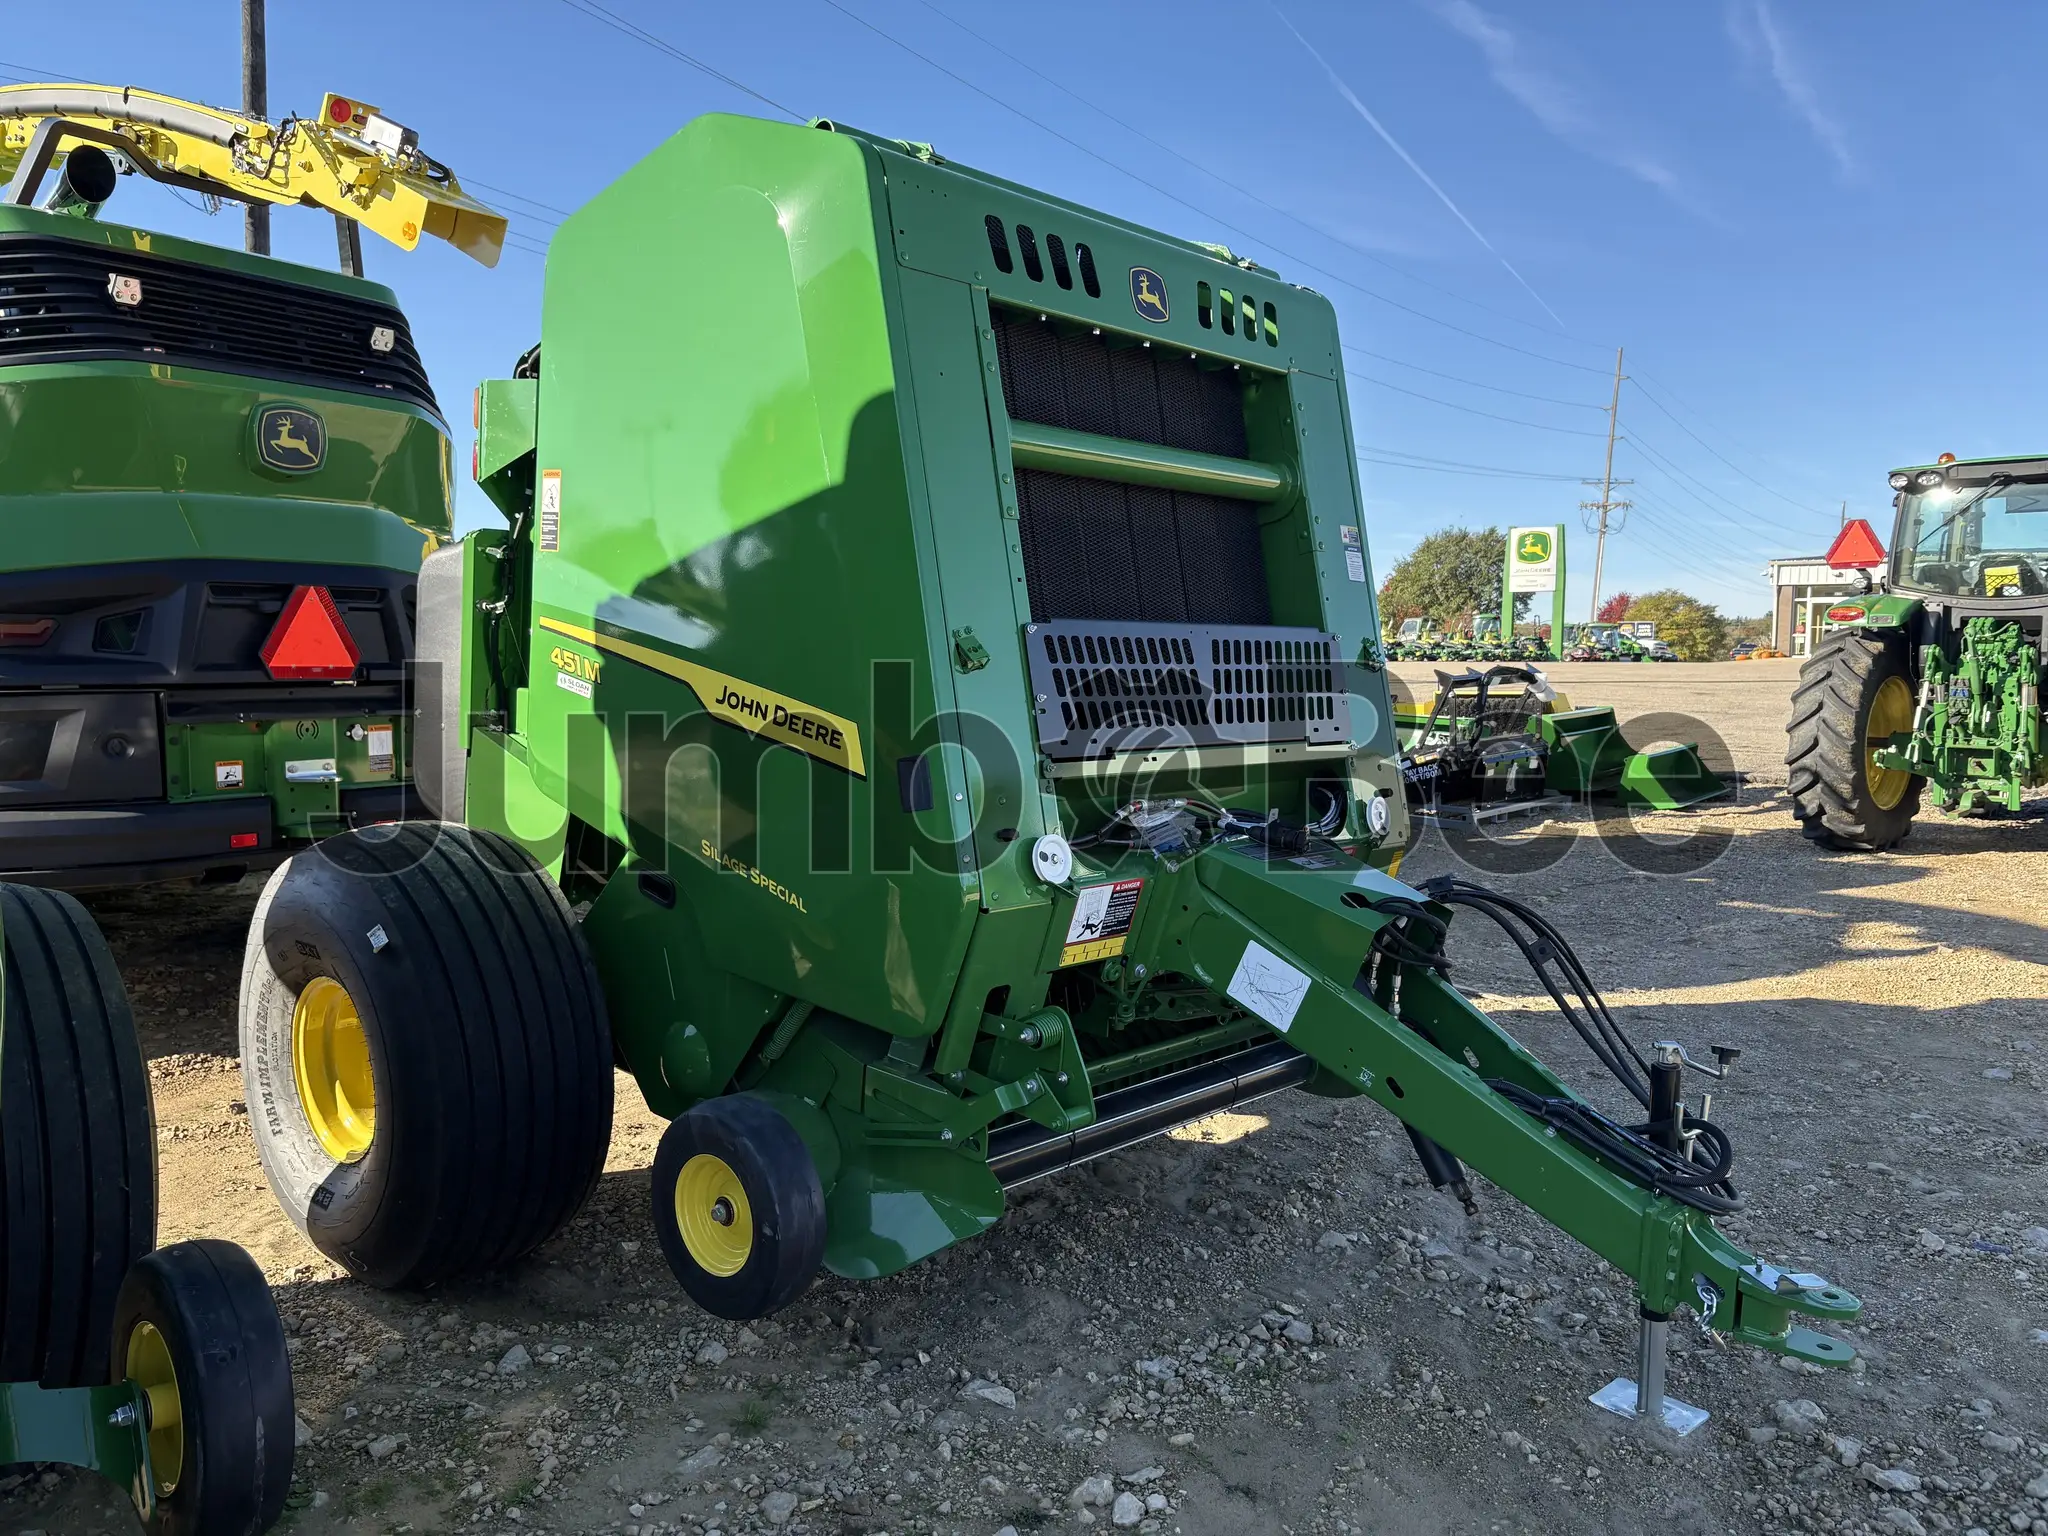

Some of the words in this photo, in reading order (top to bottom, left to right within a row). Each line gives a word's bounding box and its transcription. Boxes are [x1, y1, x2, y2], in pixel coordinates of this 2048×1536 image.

[567, 678, 590, 691] SLOAN
[715, 685, 768, 722] JOHN
[773, 704, 843, 750] DEERE
[1418, 762, 1439, 774] BACK
[1403, 768, 1442, 784] 00FT/90M
[701, 838, 748, 878] SILAGE
[750, 866, 808, 914] SPECIAL
[1120, 881, 1141, 890] DANGER
